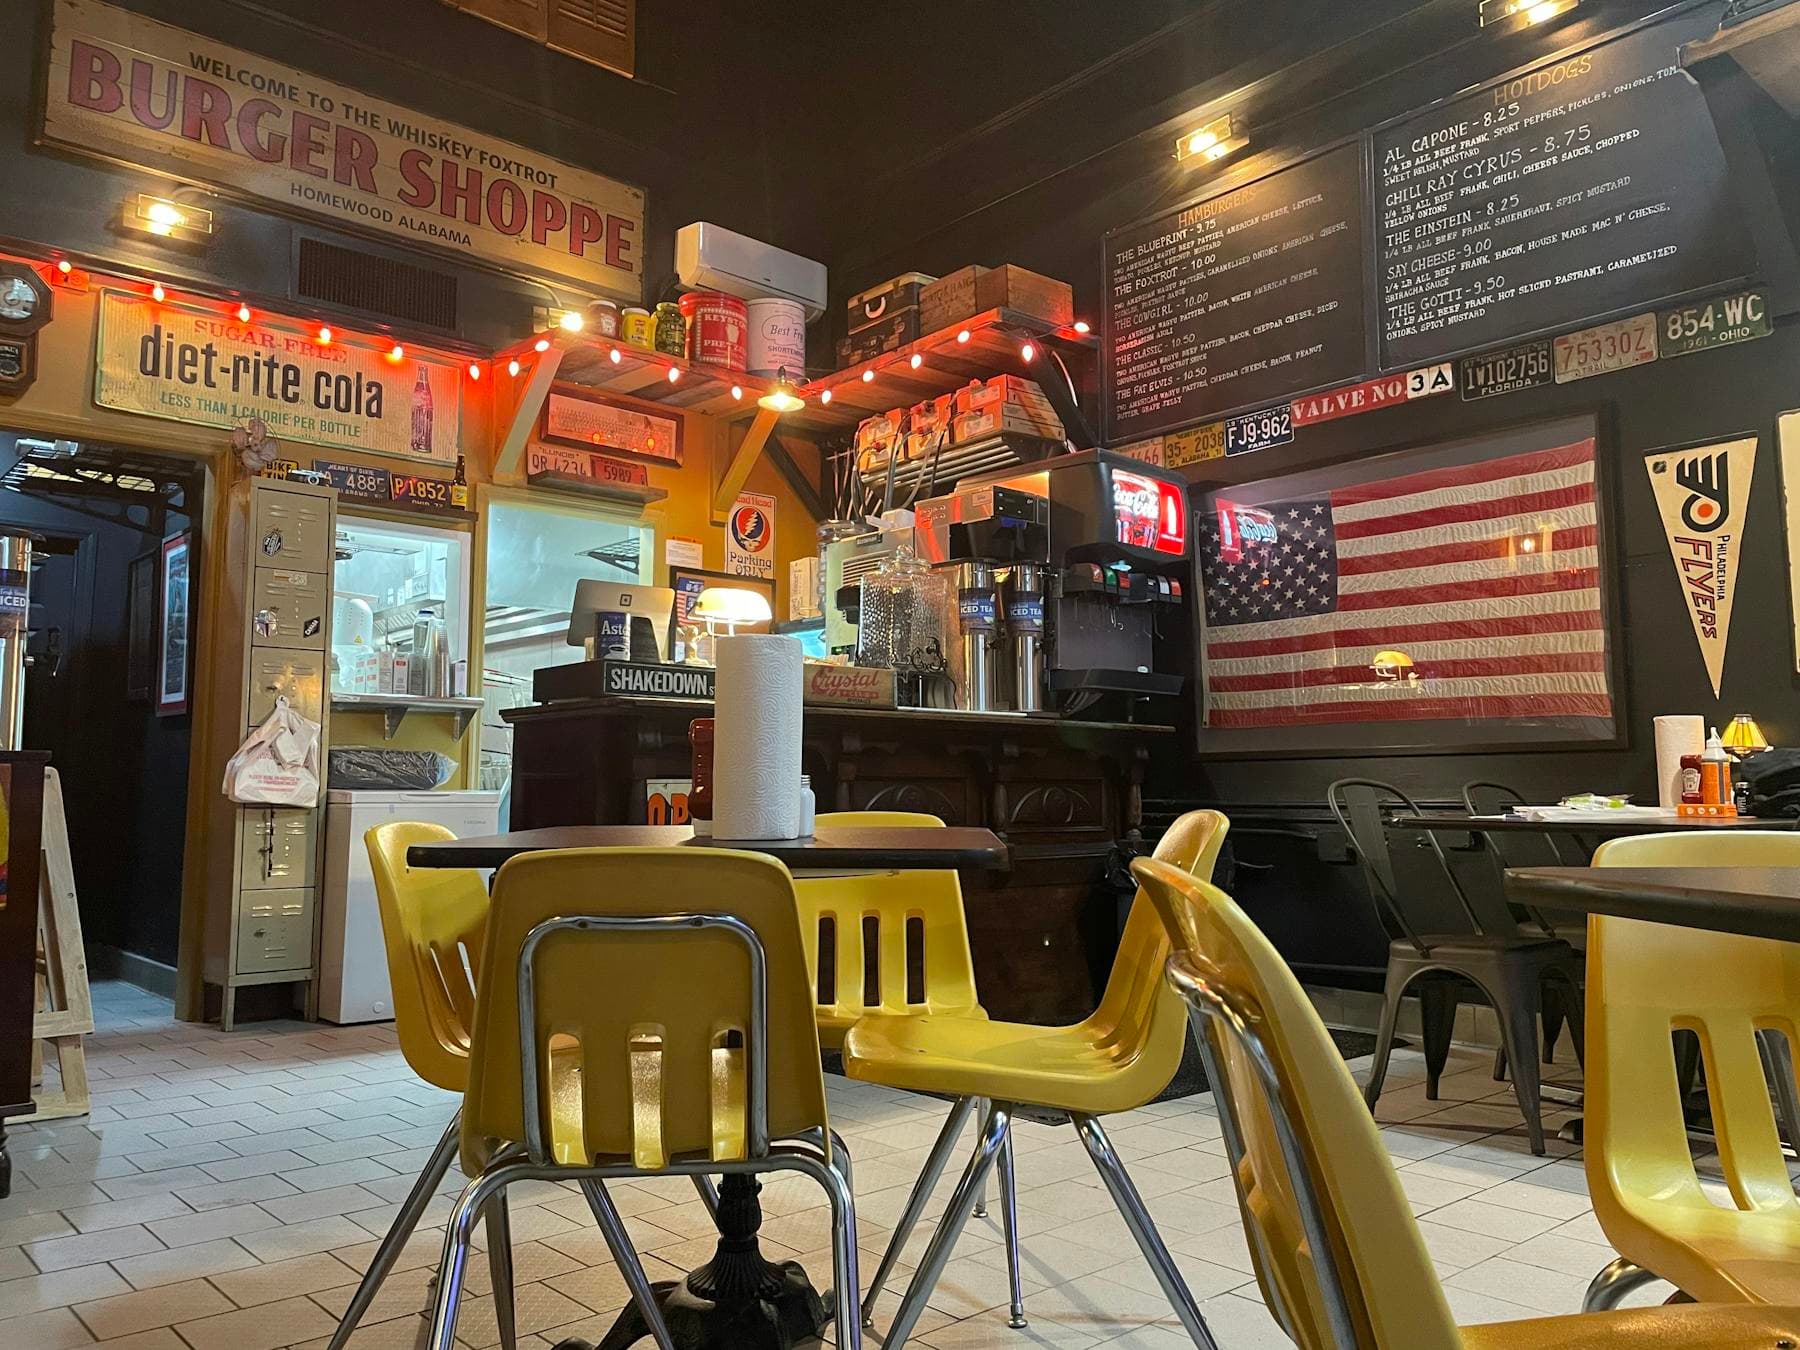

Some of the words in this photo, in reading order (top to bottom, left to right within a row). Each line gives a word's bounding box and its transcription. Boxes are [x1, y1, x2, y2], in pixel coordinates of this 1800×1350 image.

[1493, 54, 1593, 106] HOTDOGS
[189, 51, 299, 101] WELCOME
[307, 91, 334, 113] TO
[342, 103, 381, 130] THE
[387, 118, 475, 161] WHISKEY
[479, 150, 559, 189] FOXTROT
[1385, 147, 1405, 164] AL
[1412, 122, 1468, 152] CAPONE
[1483, 102, 1520, 127] 8.25
[68, 39, 379, 195] BURGER
[396, 148, 635, 272] SHOPPE
[1383, 165, 1399, 176] 1/4
[1401, 160, 1411, 170] LB
[1415, 153, 1431, 165] ALL
[1434, 144, 1456, 158] BEEF
[1493, 120, 1520, 138] SPORT
[1386, 184, 1421, 206] CHILI
[1426, 170, 1458, 193] RAY
[1463, 148, 1522, 179] CYRUS
[1544, 124, 1591, 153] 8.75
[1385, 171, 1411, 186] SWEET
[1443, 148, 1479, 167] MUSTARD
[1385, 210, 1396, 219] 1/4
[1402, 205, 1411, 214] LB
[1416, 199, 1431, 210] ALL
[1434, 191, 1454, 204] BEEF
[1523, 155, 1558, 175] CHEESE
[1595, 129, 1640, 151] CHOPPED
[290, 182, 393, 223] HOMEWOOD
[398, 214, 472, 247] ALABAMA
[1178, 187, 1257, 228] HAMBURGERS
[1385, 213, 1415, 228] YELLOW
[1418, 204, 1447, 219] ONIONS
[1385, 249, 1398, 258] 1/4
[1402, 245, 1413, 253] LB
[1416, 240, 1432, 250] ALL
[1435, 232, 1457, 245] BEEF
[1556, 191, 1583, 208] SPICY
[1587, 176, 1631, 198] MUSTARD
[1385, 229, 1410, 246] THE
[1415, 211, 1471, 238] EINSTEIN
[1487, 194, 1520, 216] 8.25
[1116, 249, 1134, 264] THE
[1137, 229, 1188, 256] BLUEPRINT
[1385, 283, 1399, 293] 1/4
[1401, 279, 1412, 288] LB
[1415, 273, 1431, 284] ALL
[1434, 265, 1456, 278] BEEF
[1528, 234, 1558, 251] HOUSE
[1561, 225, 1588, 241] MADE
[1592, 218, 1612, 232] MAC
[1387, 262, 1408, 280] SAY
[1411, 249, 1456, 273] CHEESE
[1464, 239, 1491, 257] 9.00
[1114, 282, 1132, 296] THE
[1135, 266, 1178, 290] FOXTROT
[1386, 320, 1400, 330] 1/4
[1403, 316, 1414, 325] LB
[1418, 311, 1434, 322] ALL
[1437, 304, 1460, 317] BEEF
[1498, 289, 1516, 301] HOT
[1518, 279, 1551, 295] SLICED
[1607, 245, 1677, 271] CARAMELIZED
[1388, 302, 1416, 319] THE
[1420, 288, 1462, 310] GOTTI
[1474, 276, 1505, 294] 9.50
[1425, 278, 1449, 291] SAUCE
[1115, 318, 1131, 330] THE
[1133, 304, 1173, 325] COWGIRL
[1184, 292, 1208, 308] 10.00
[1253, 319, 1283, 335] CHEDDAR
[1317, 300, 1339, 314] DICED
[1420, 318, 1444, 331] SPICY
[1448, 308, 1485, 325] MUSTARD
[769, 324, 790, 337] Best
[1719, 327, 1750, 341] OHIO
[1115, 354, 1131, 366] THE
[1133, 343, 1162, 360] CLASSIC
[1172, 334, 1195, 348] 10.50
[1295, 344, 1323, 359] PEANUT
[139, 324, 301, 404] diet-rite
[314, 370, 384, 419] cola
[1116, 389, 1131, 400] THE
[1133, 384, 1147, 396] FAT
[1149, 377, 1173, 392] ELVIS
[1184, 367, 1207, 381] 10.50
[1481, 378, 1532, 396] FLORIDA
[160, 391, 191, 408] LESS
[196, 397, 228, 416] THAN
[230, 402, 240, 418] 1
[242, 405, 289, 426] CALORIE
[293, 415, 315, 432] PER
[319, 420, 361, 438] BOTTLE
[1240, 411, 1276, 424] KENTUCKY
[1292, 391, 1365, 420] VALVE
[1372, 380, 1407, 402] NO.
[1194, 431, 1224, 453] 2038
[1247, 439, 1271, 449] FARM
[532, 453, 548, 470] QR
[408, 479, 446, 501] 1852
[729, 551, 772, 570] Parking
[1716, 535, 1730, 601] PHILADELPHIA
[1674, 536, 1717, 639] FLYERS
[980, 605, 993, 614] TEA
[1029, 607, 1042, 616] TEA
[610, 668, 707, 696] SHAKEDOWN
[811, 666, 879, 694] Crystal
